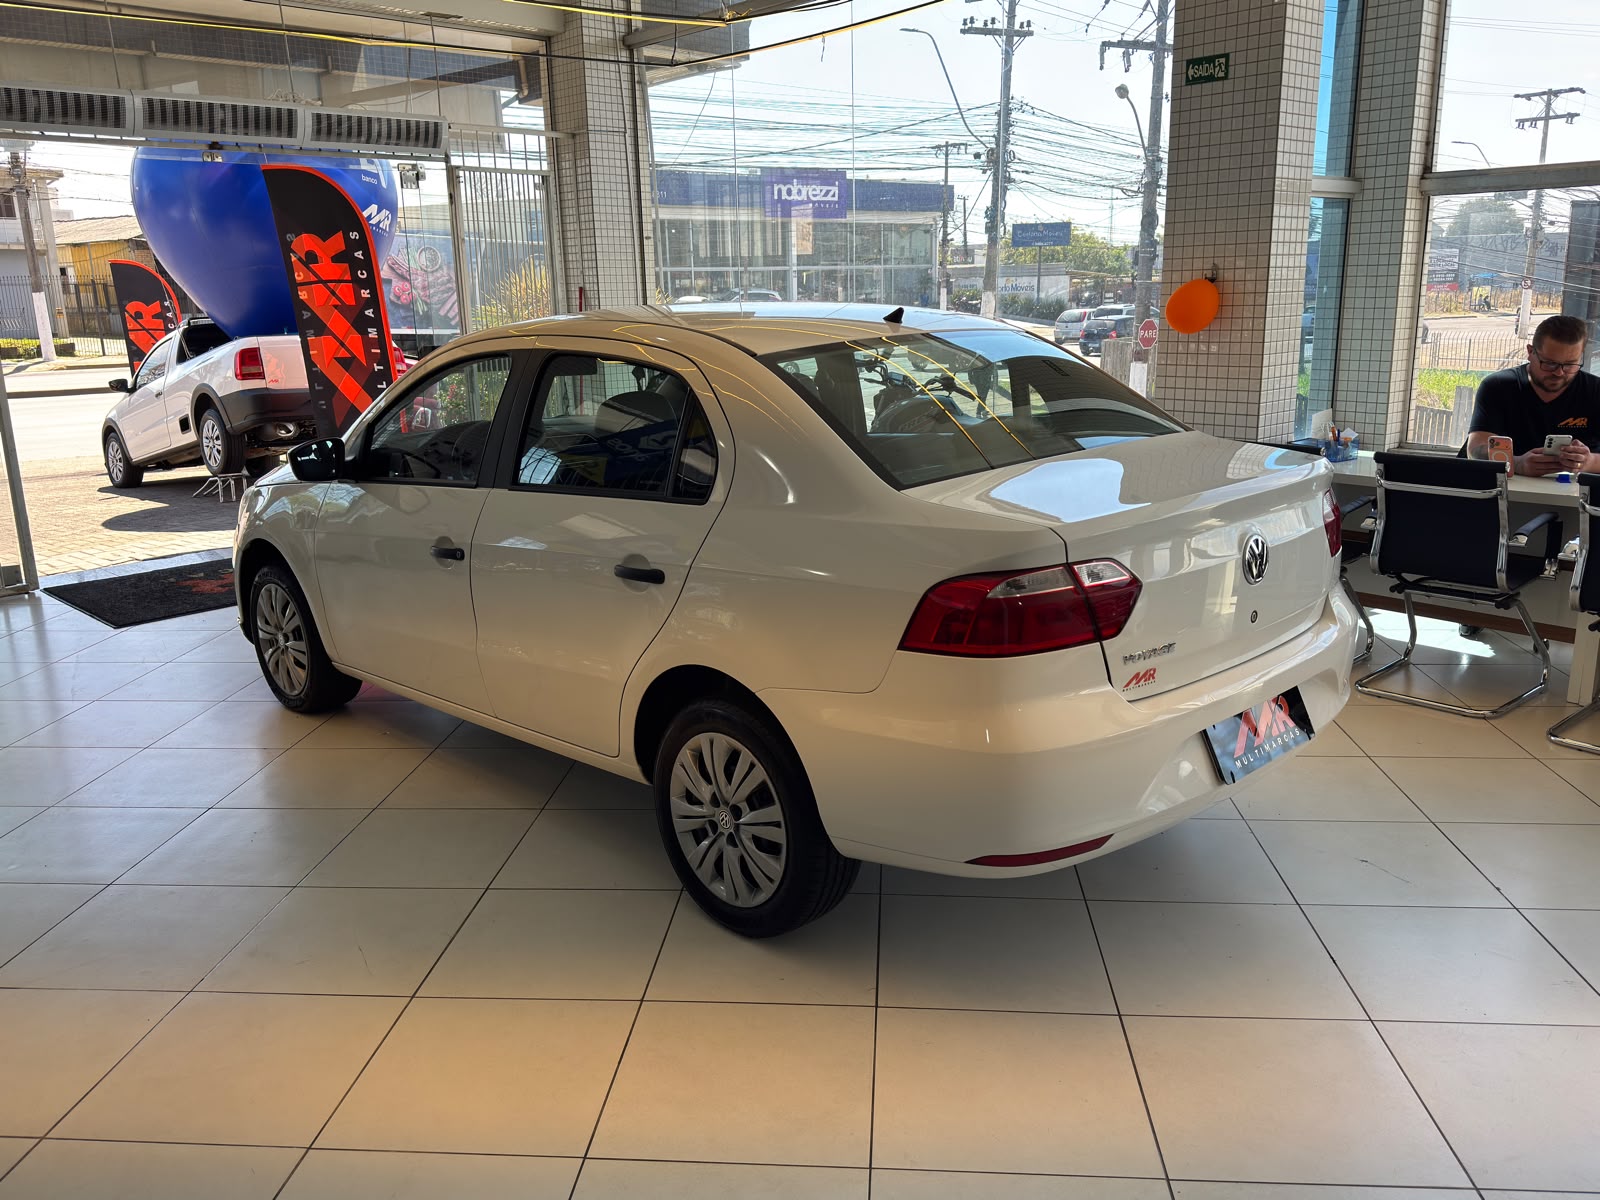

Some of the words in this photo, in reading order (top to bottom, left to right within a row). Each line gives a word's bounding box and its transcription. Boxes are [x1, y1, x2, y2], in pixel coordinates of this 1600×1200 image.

[1193, 61, 1215, 78] SAÍDA
[361, 174, 378, 185] banco
[773, 178, 839, 201] nobrezzi
[349, 231, 387, 389] LTIMARCAS
[1140, 329, 1157, 339] PARE
[1123, 667, 1157, 689] MR
[1233, 695, 1297, 758] MR
[1235, 728, 1301, 769] MULTIMARCAS
